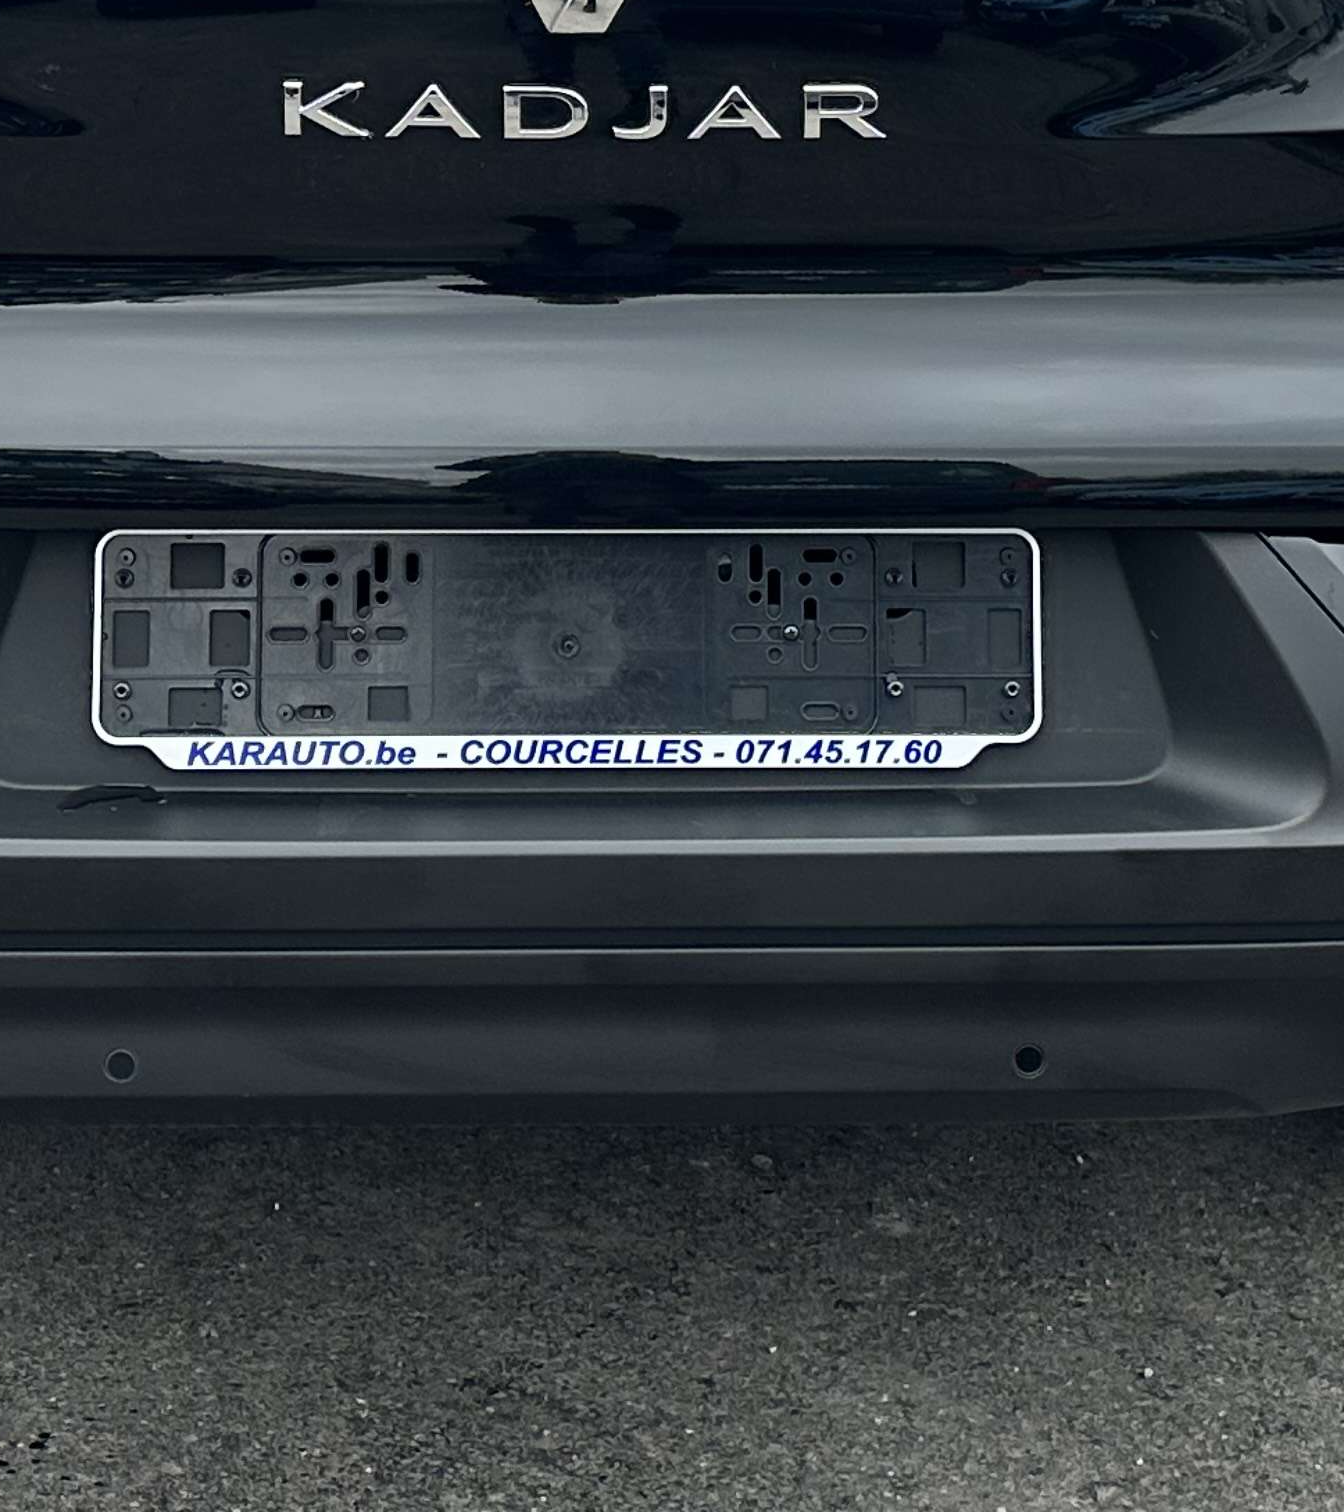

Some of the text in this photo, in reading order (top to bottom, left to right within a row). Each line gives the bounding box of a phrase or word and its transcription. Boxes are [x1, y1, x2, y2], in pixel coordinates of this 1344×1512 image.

[282, 81, 887, 140] KADJAR
[187, 740, 417, 766] KARAUTO.be
[460, 739, 703, 765] COURCELLES
[735, 739, 943, 765] 071.45.17.60
